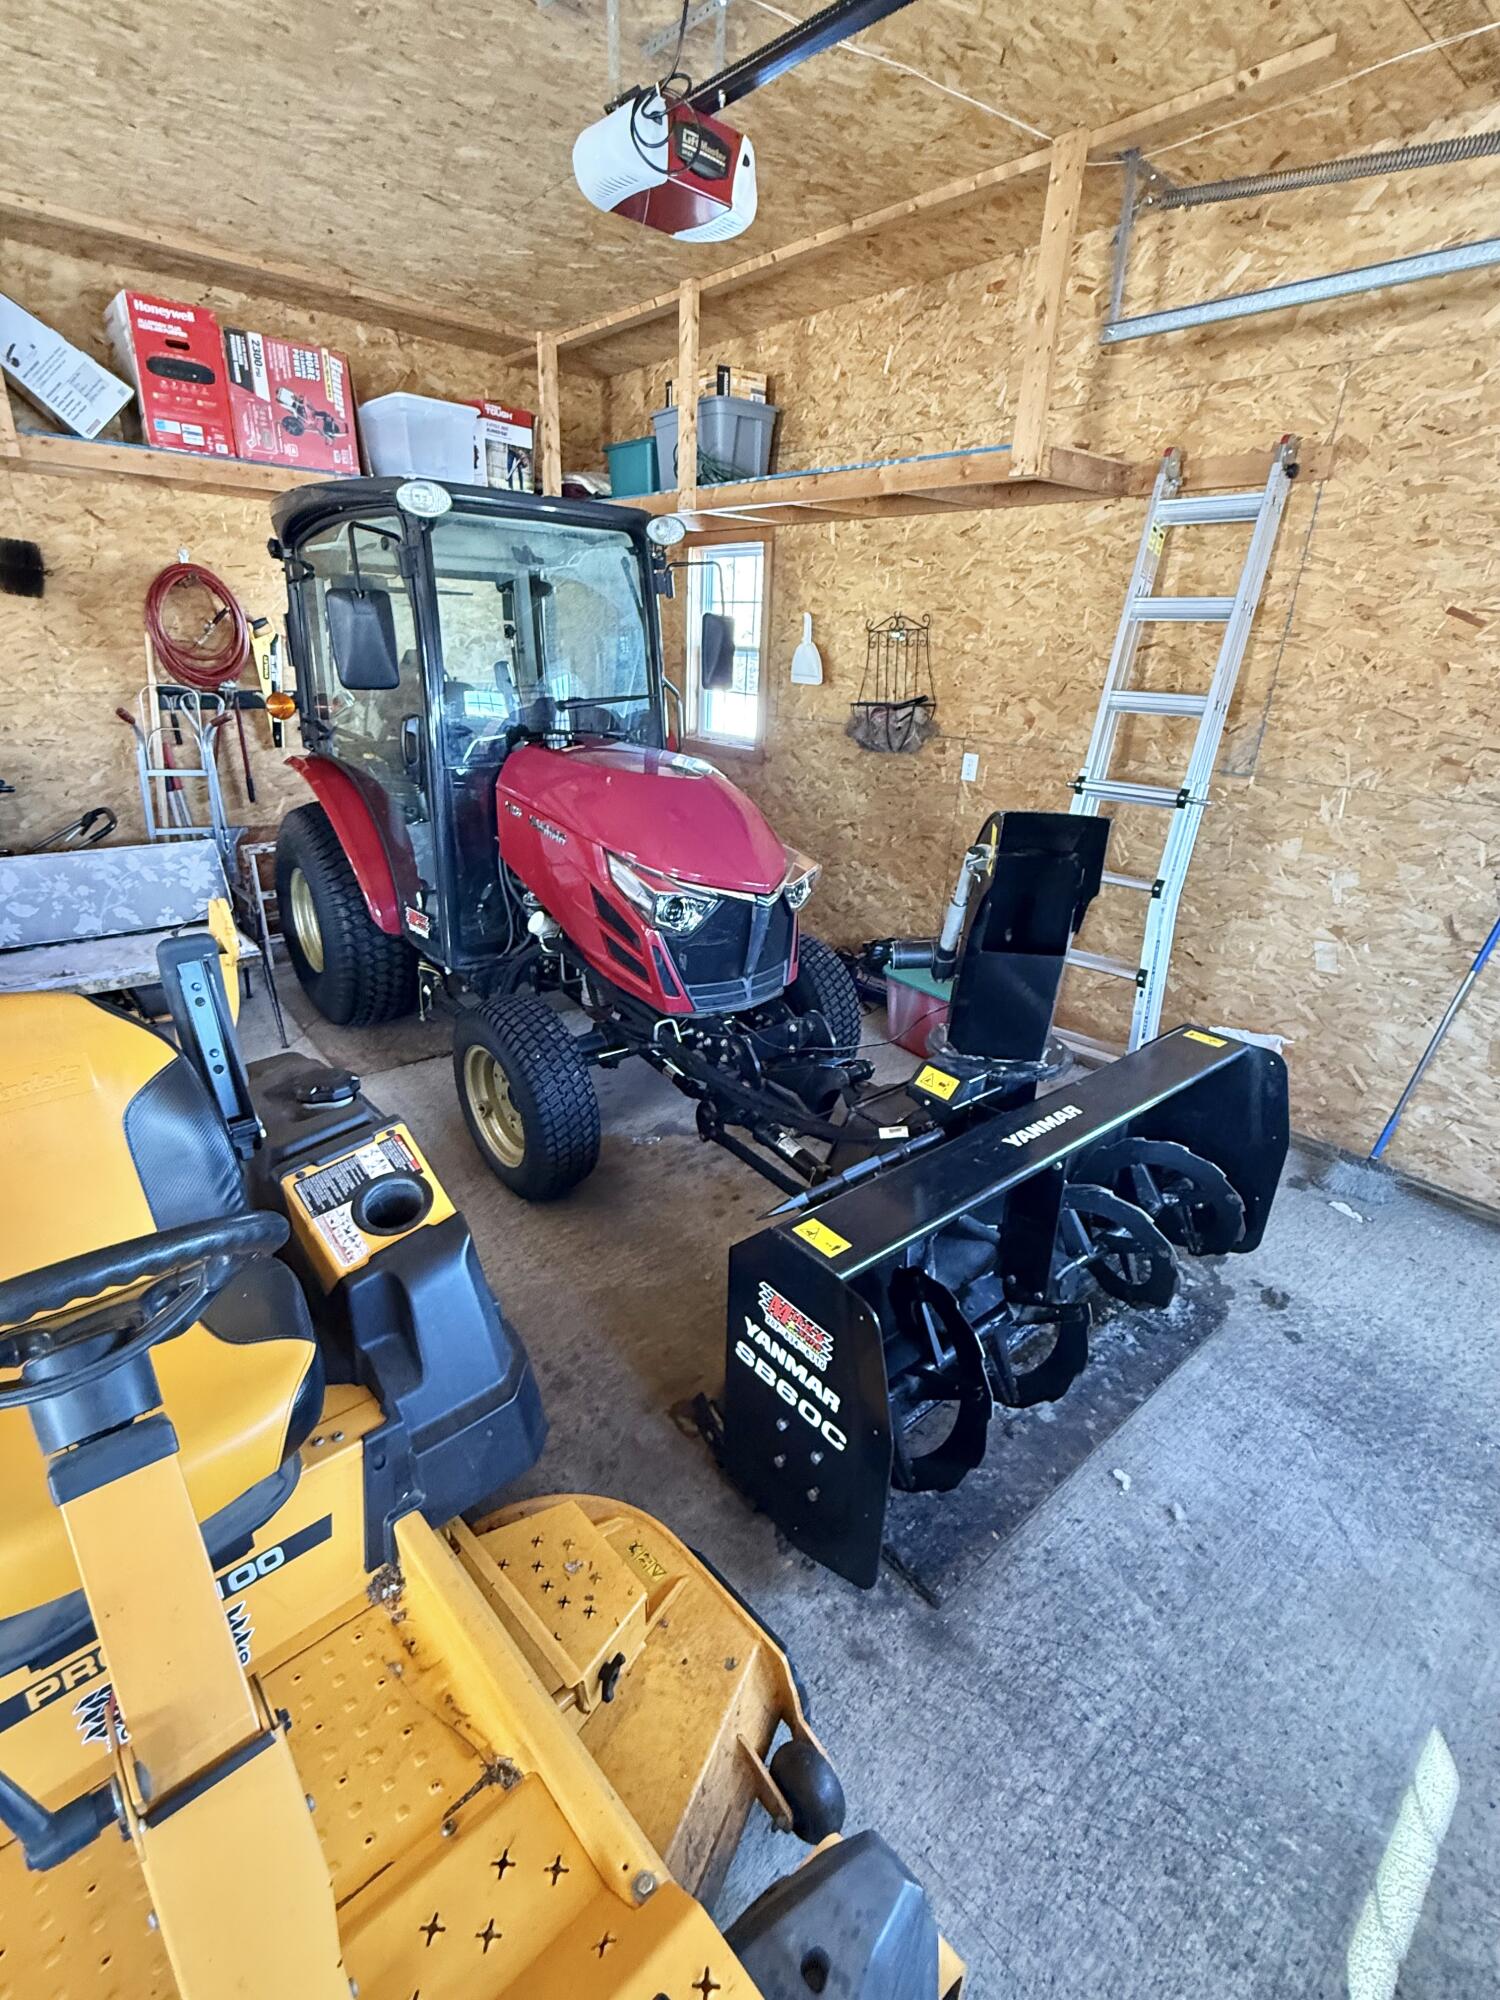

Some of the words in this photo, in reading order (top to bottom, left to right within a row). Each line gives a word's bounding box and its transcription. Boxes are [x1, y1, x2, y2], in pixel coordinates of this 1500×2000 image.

[133, 299, 195, 322] Honeywell
[251, 339, 263, 367] 2300
[1001, 1104, 1083, 1147] YANMAR
[744, 1316, 841, 1414] YANMAR
[735, 1340, 847, 1452] SB60C
[25, 1650, 106, 1712] PR
